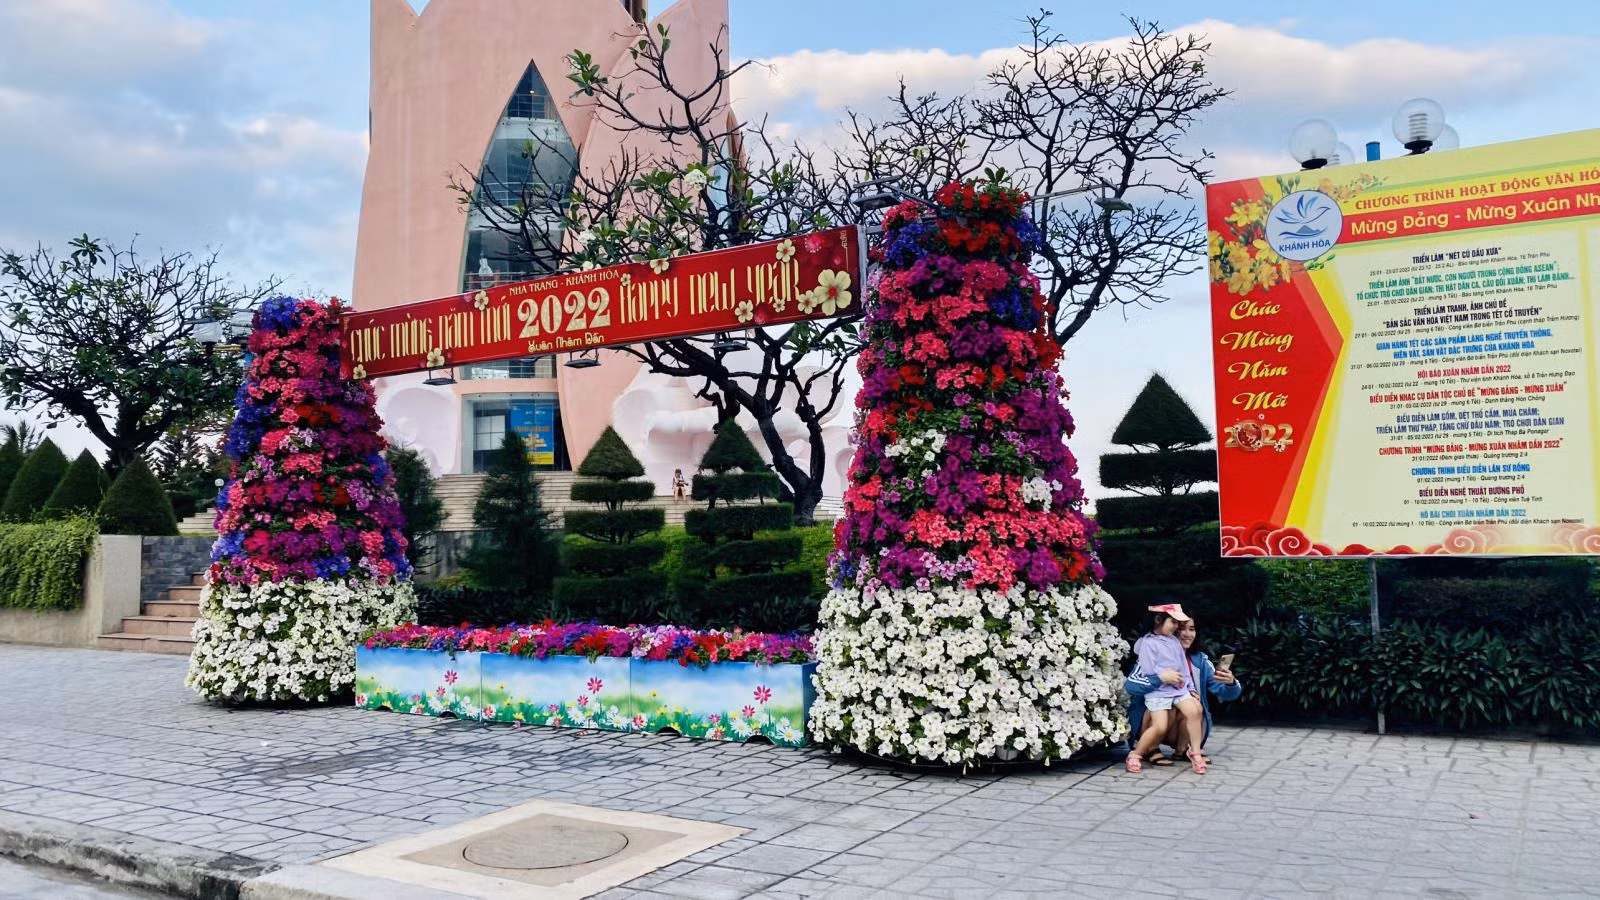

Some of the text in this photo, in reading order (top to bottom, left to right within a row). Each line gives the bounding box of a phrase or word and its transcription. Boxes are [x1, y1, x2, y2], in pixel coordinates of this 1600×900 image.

[1356, 194, 1409, 210] CHƯƠNG
[1414, 188, 1454, 203] TRÌNH
[1460, 182, 1496, 196] HOẠT
[1502, 177, 1540, 192] ĐỘNG
[1545, 172, 1574, 186] VĂN
[1352, 218, 1397, 235] Mừng
[1403, 212, 1448, 229] Đảng
[1466, 205, 1516, 222] Mừng
[1522, 197, 1570, 215] Xuân
[1279, 239, 1330, 252] KHÁNH HÒA
[510, 269, 619, 296] NHA TRANG KHÁNH HÒA
[518, 287, 611, 339] 2022
[1230, 300, 1281, 320] Chúc
[1470, 312, 1490, 320] TRONG
[1220, 330, 1294, 352] Mừng
[1227, 360, 1289, 380] Năm
[1232, 391, 1288, 410] Mới
